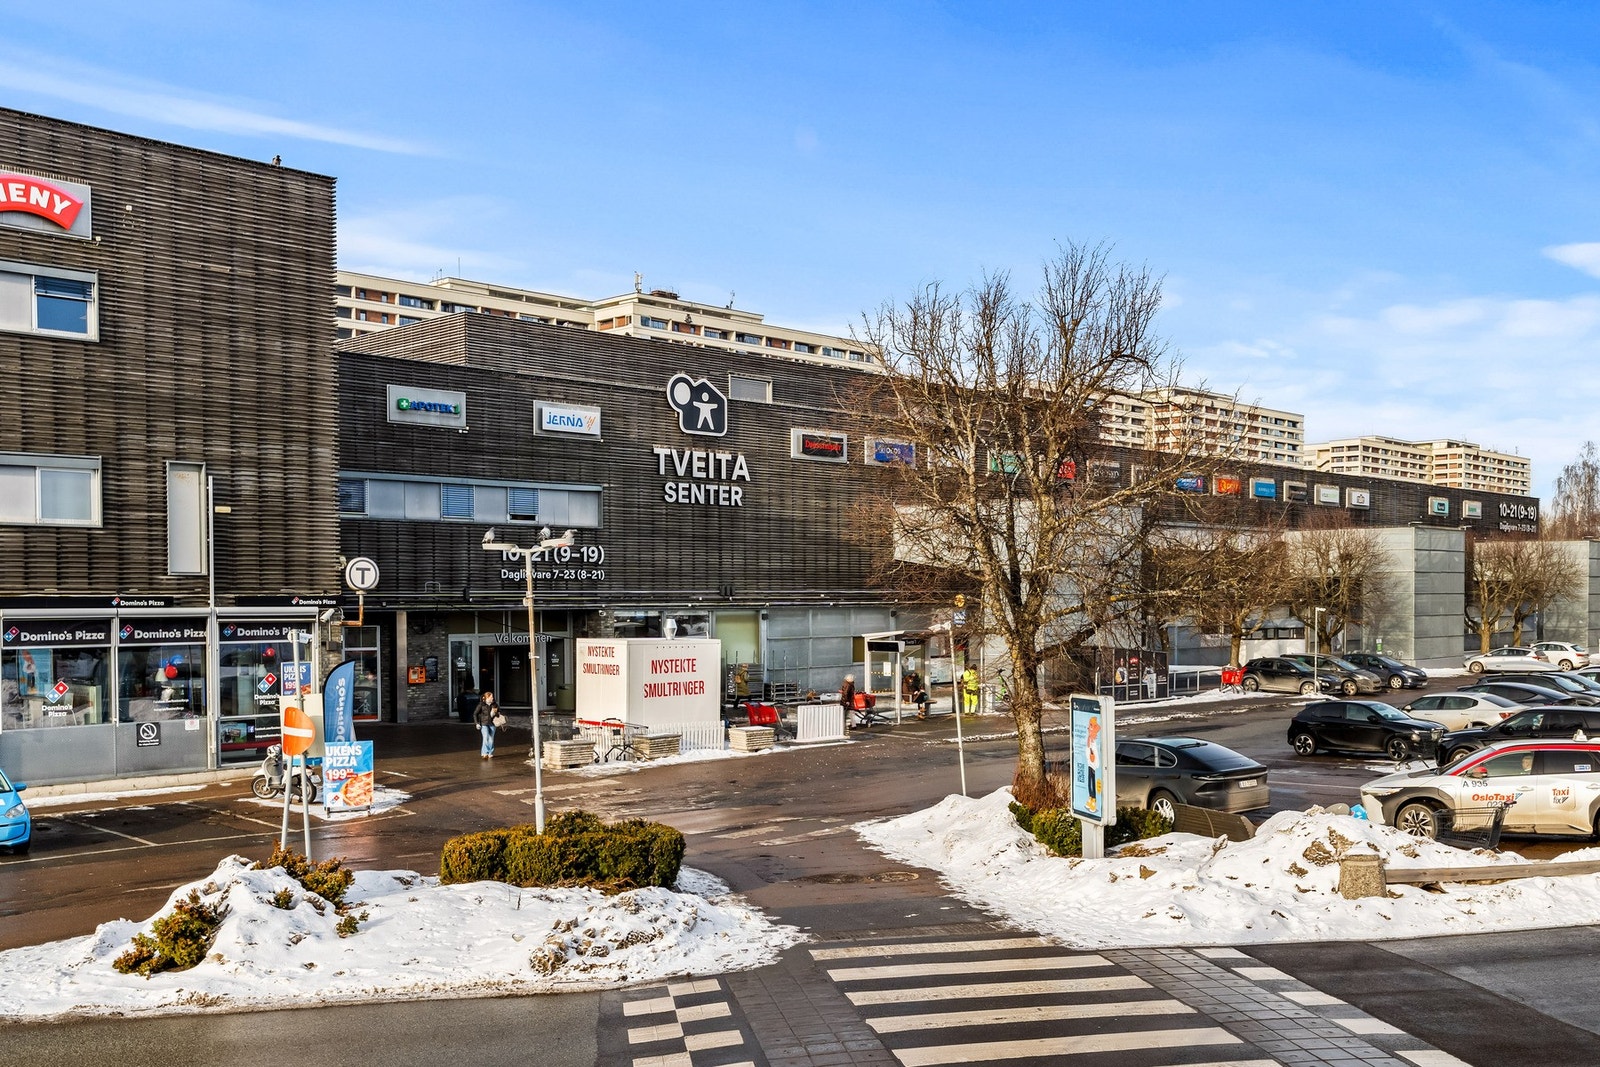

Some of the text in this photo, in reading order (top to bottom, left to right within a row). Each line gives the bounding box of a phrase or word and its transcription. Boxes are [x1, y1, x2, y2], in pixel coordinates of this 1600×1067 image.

[653, 447, 751, 481] TVEITA
[664, 481, 743, 506] SENTER
[553, 545, 605, 565] (9-19)
[356, 567, 371, 585] T
[501, 569, 605, 581] Daglivare 7-23 (8-21)
[20, 631, 106, 641] Domino's Pizza
[134, 629, 181, 639] Domino's
[237, 627, 280, 636] Domino's
[587, 645, 615, 658] NYSTEKTE
[582, 664, 620, 676] SMULTRINGER
[651, 658, 697, 674] NYSTEKTE
[643, 680, 705, 698] SMULTRINGER
[42, 703, 73, 711] Domino's
[325, 745, 362, 756] UKENS
[326, 757, 357, 767] PIZZA
[327, 769, 347, 780] 199
[1462, 780, 1488, 788] A 935
[1552, 786, 1570, 796] Taxi
[1472, 793, 1514, 801] OsloTaxi
